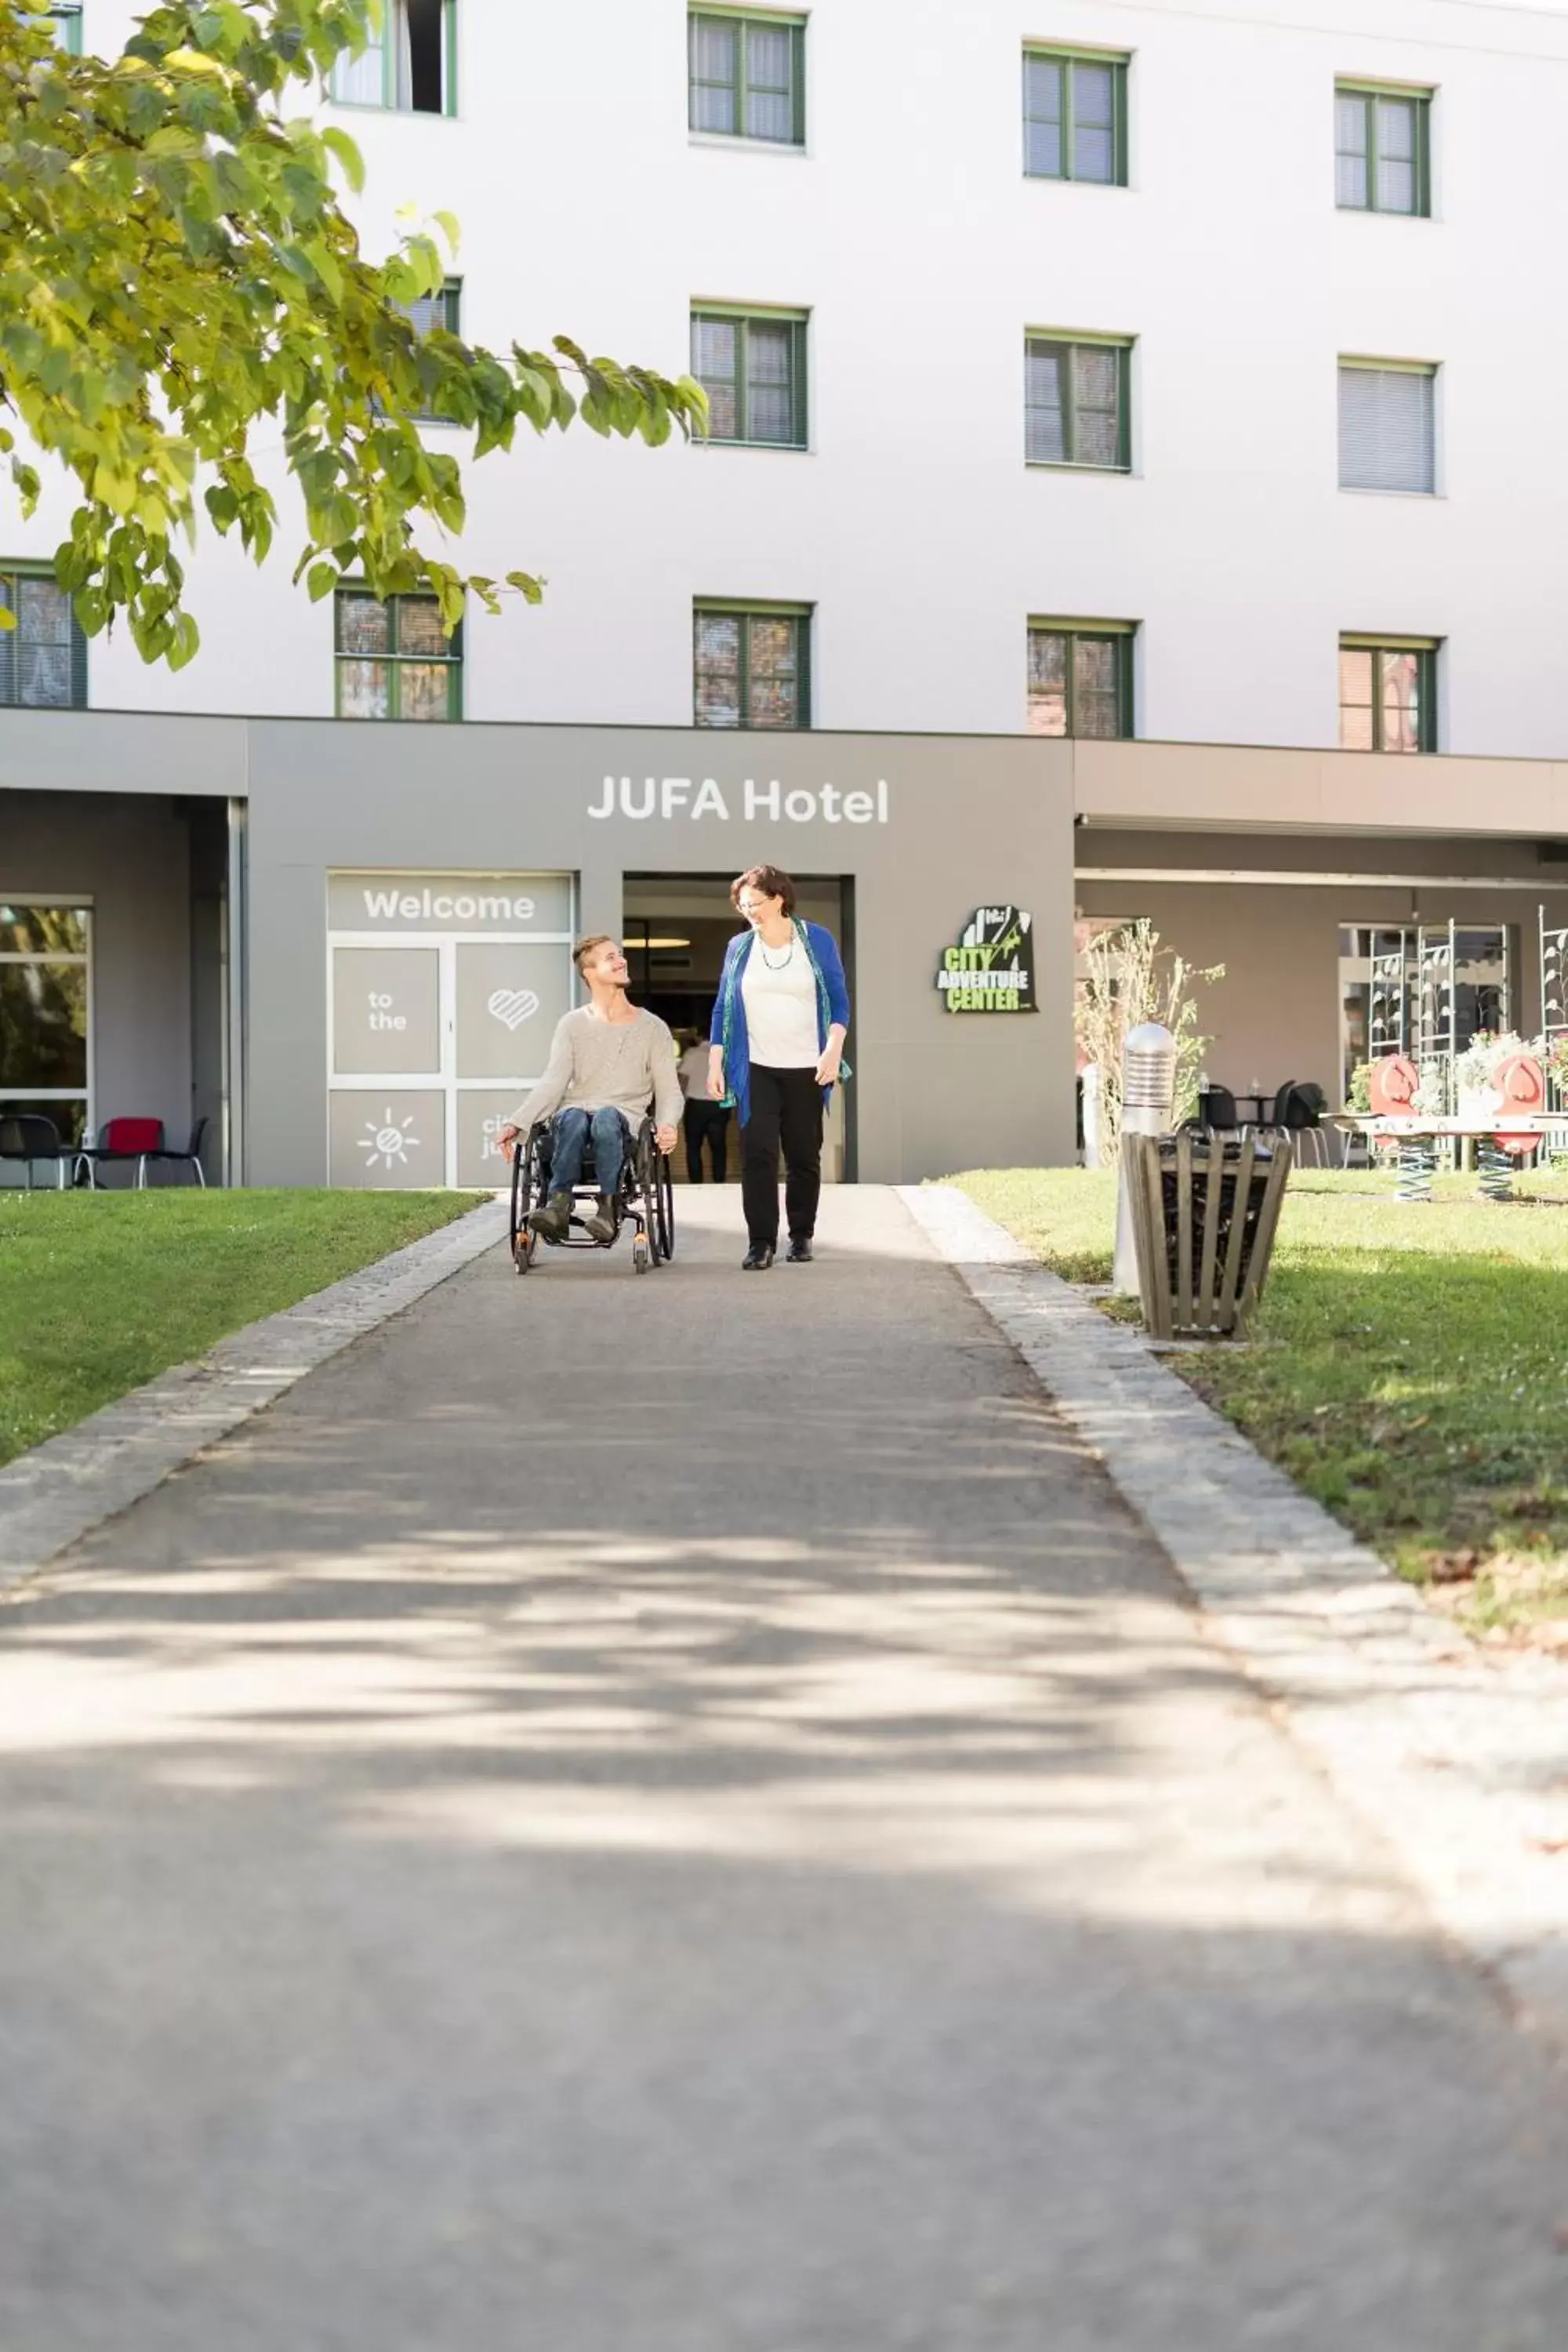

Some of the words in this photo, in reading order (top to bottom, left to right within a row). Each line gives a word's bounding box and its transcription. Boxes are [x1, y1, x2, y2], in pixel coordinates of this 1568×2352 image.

[587, 775, 729, 820] JUFA
[744, 779, 888, 823] Hotel
[363, 887, 535, 920] Welcome
[944, 947, 993, 971] CITY
[937, 971, 1029, 989] ADVENTURE
[368, 991, 394, 1009] to
[947, 989, 1018, 1011] CENTER
[369, 1011, 407, 1030] the
